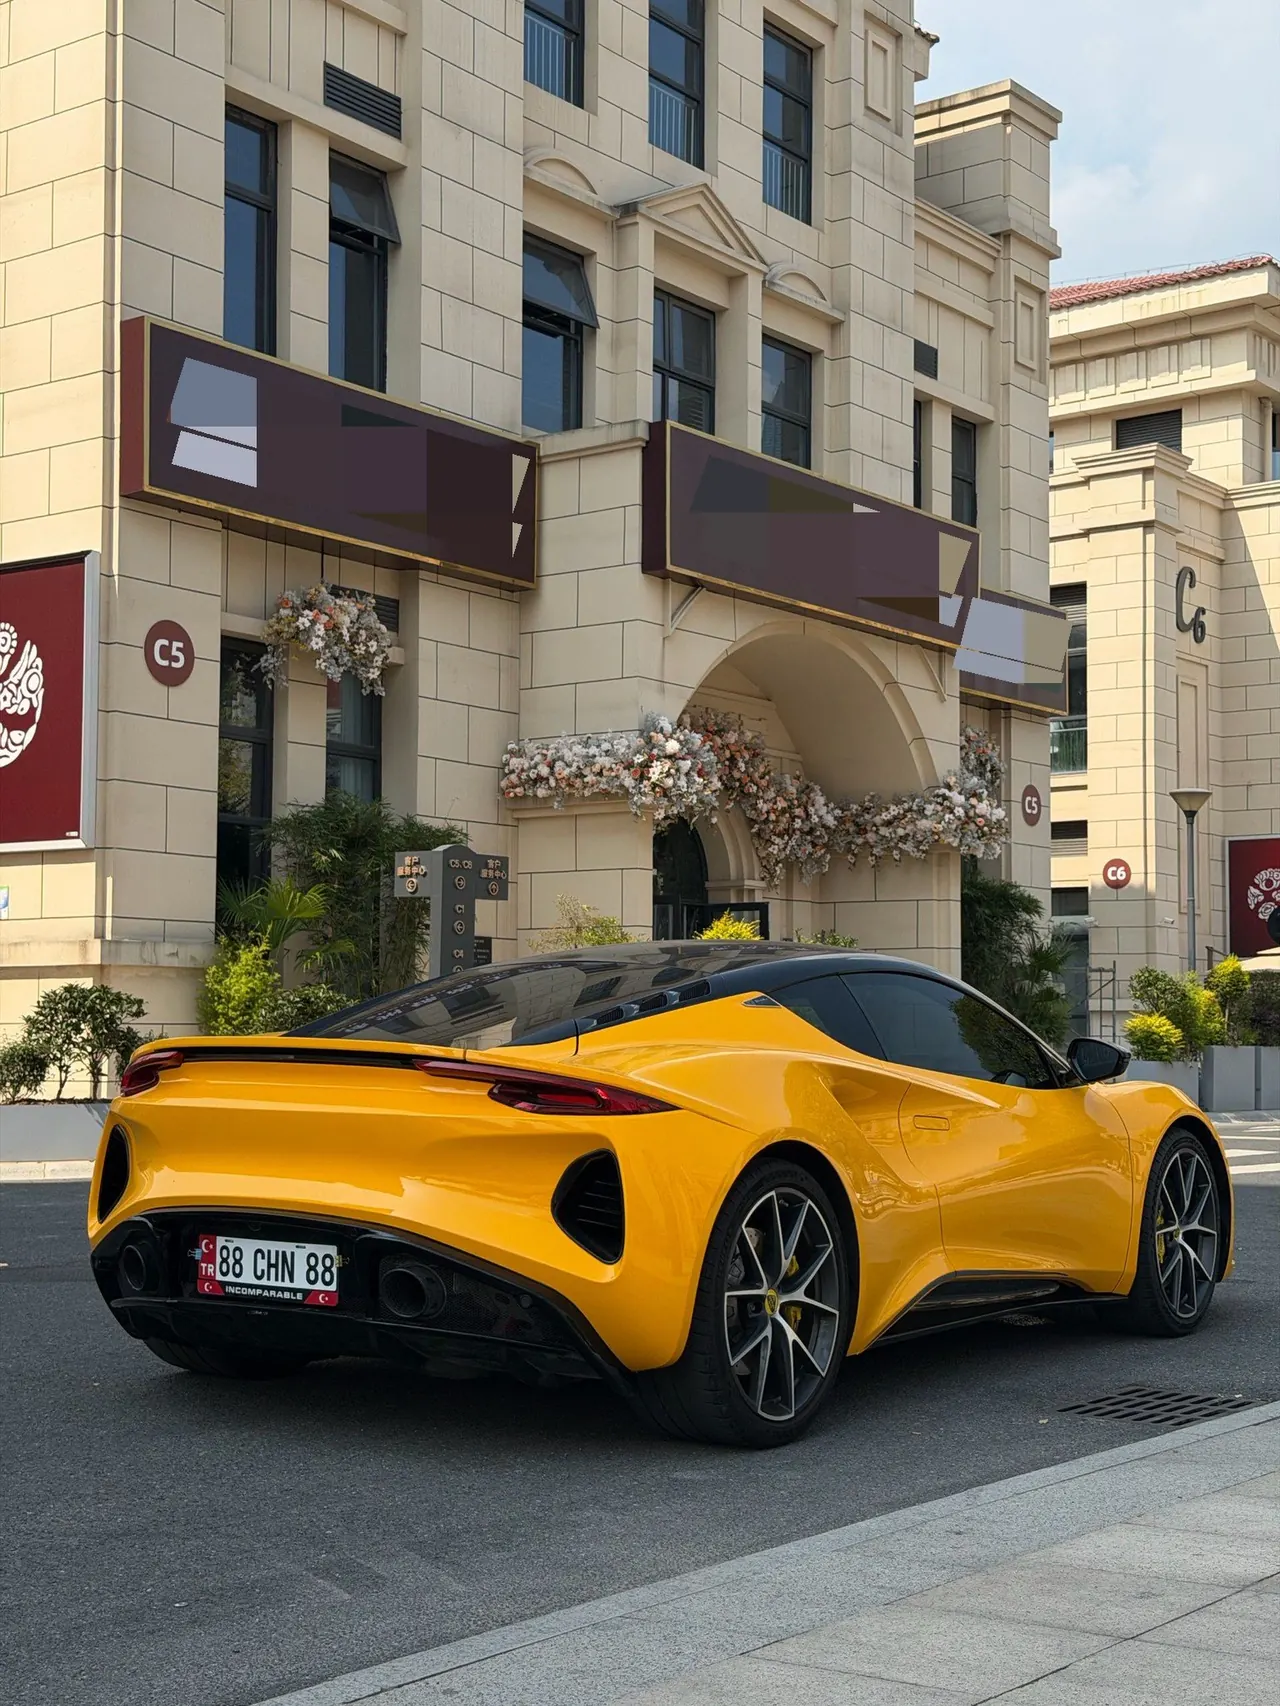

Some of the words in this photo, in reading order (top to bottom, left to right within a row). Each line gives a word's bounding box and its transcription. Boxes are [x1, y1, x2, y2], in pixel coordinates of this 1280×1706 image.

[153, 638, 185, 669] C5
[1025, 796, 1038, 815] C5
[1107, 866, 1127, 881] C6
[453, 949, 464, 959] C4
[200, 1262, 215, 1277] TR
[219, 1245, 244, 1279] 88
[253, 1248, 295, 1284] CHN
[305, 1252, 335, 1287] 88
[225, 1285, 303, 1301] INCOMPARABLE
